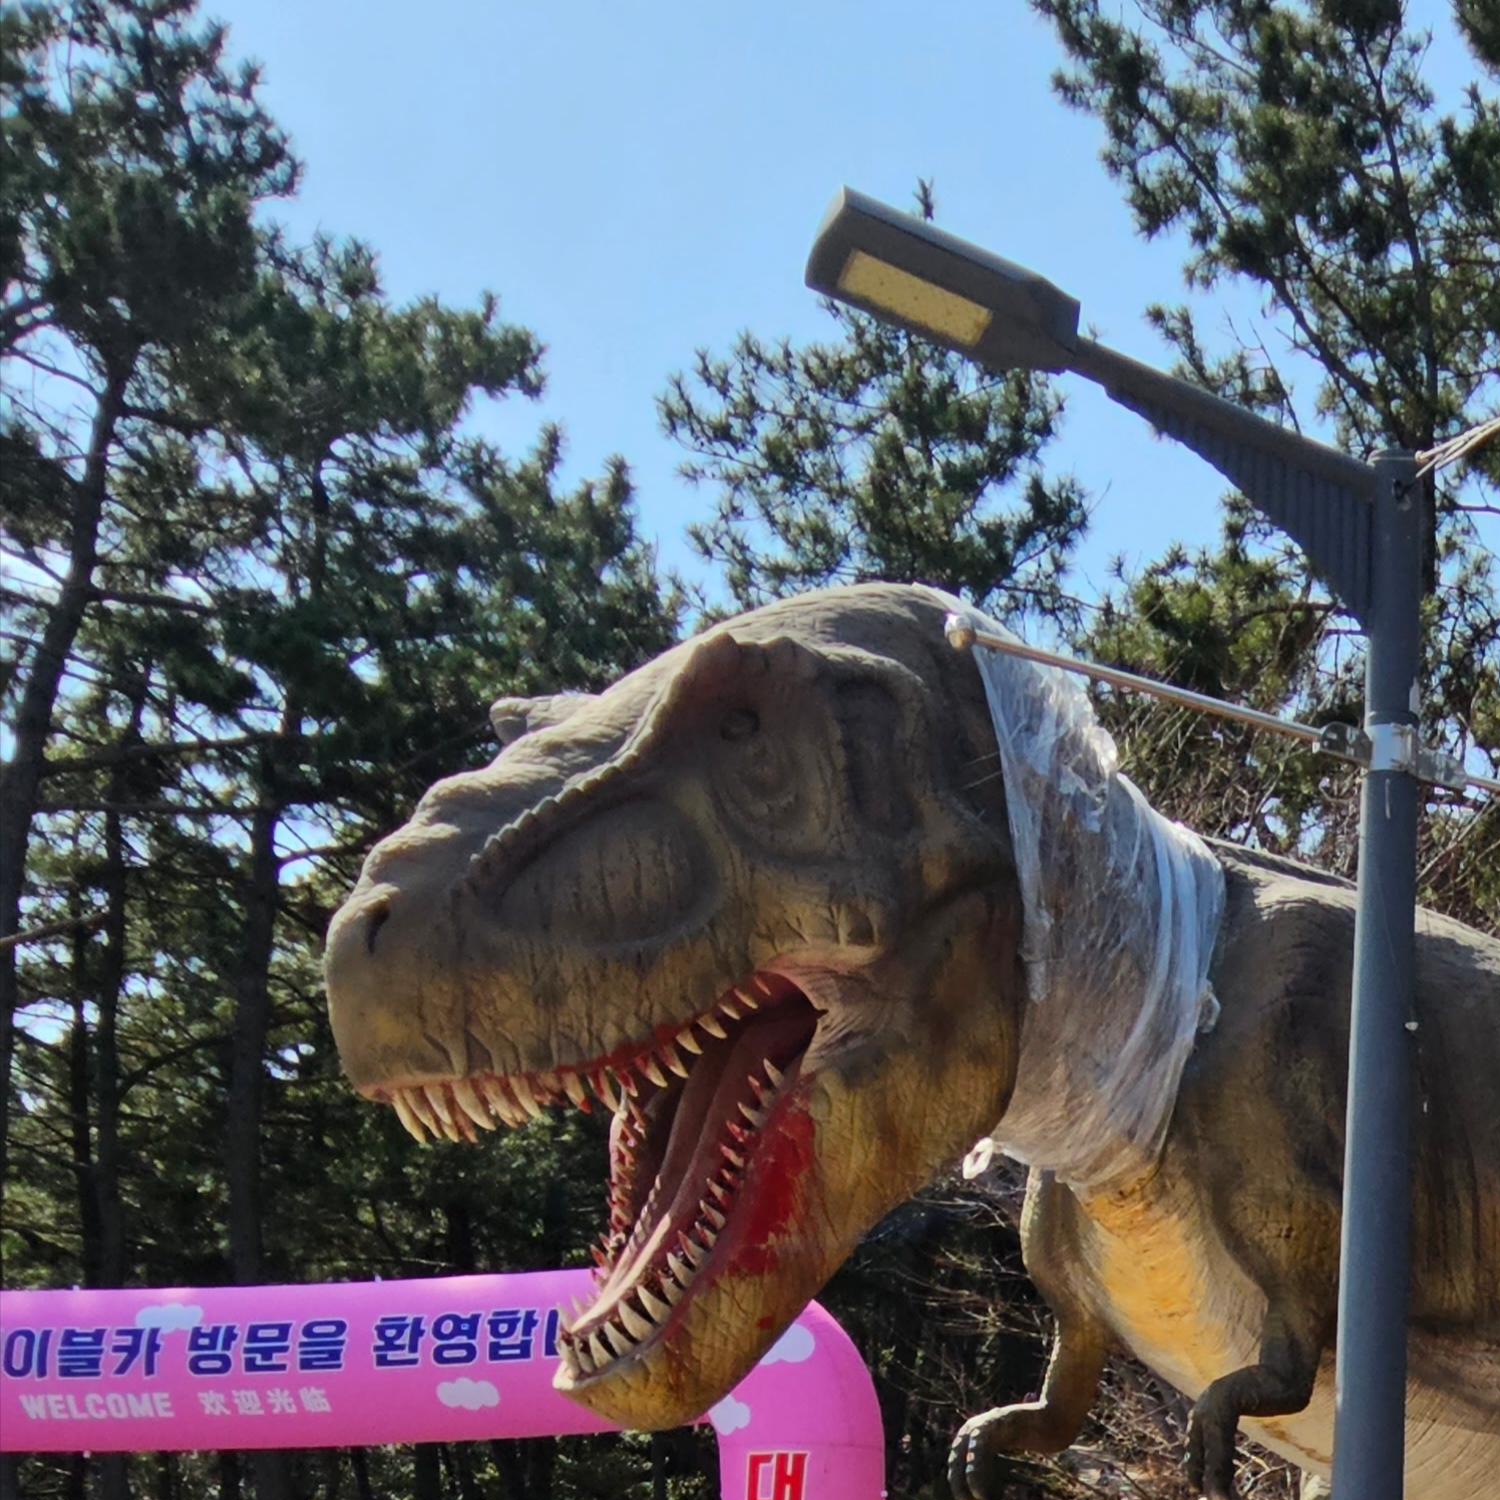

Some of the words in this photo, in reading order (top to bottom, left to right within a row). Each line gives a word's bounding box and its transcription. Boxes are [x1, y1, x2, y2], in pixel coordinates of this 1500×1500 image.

[3, 1326, 162, 1379] 이블카
[188, 1319, 348, 1376] 방문을
[18, 1392, 175, 1420] WELCOME
[198, 1386, 332, 1415] 欢迎光临
